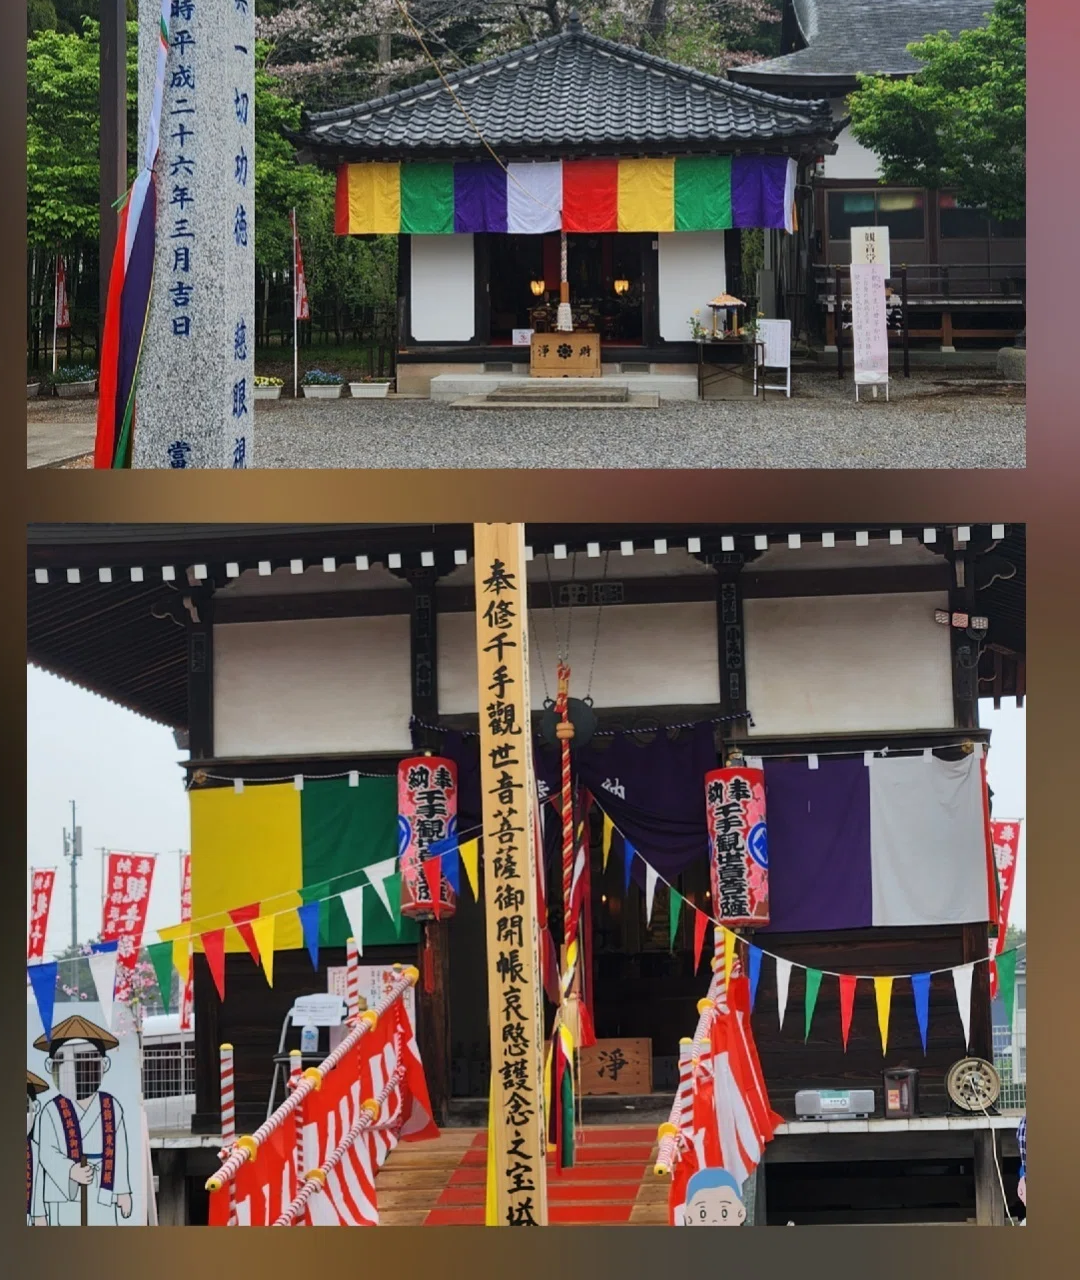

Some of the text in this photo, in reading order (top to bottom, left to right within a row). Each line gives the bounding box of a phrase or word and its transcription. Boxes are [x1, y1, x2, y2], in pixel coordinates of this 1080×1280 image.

[408, 764, 453, 792] 奉納
[714, 803, 751, 919] 千手観世音菩薩
